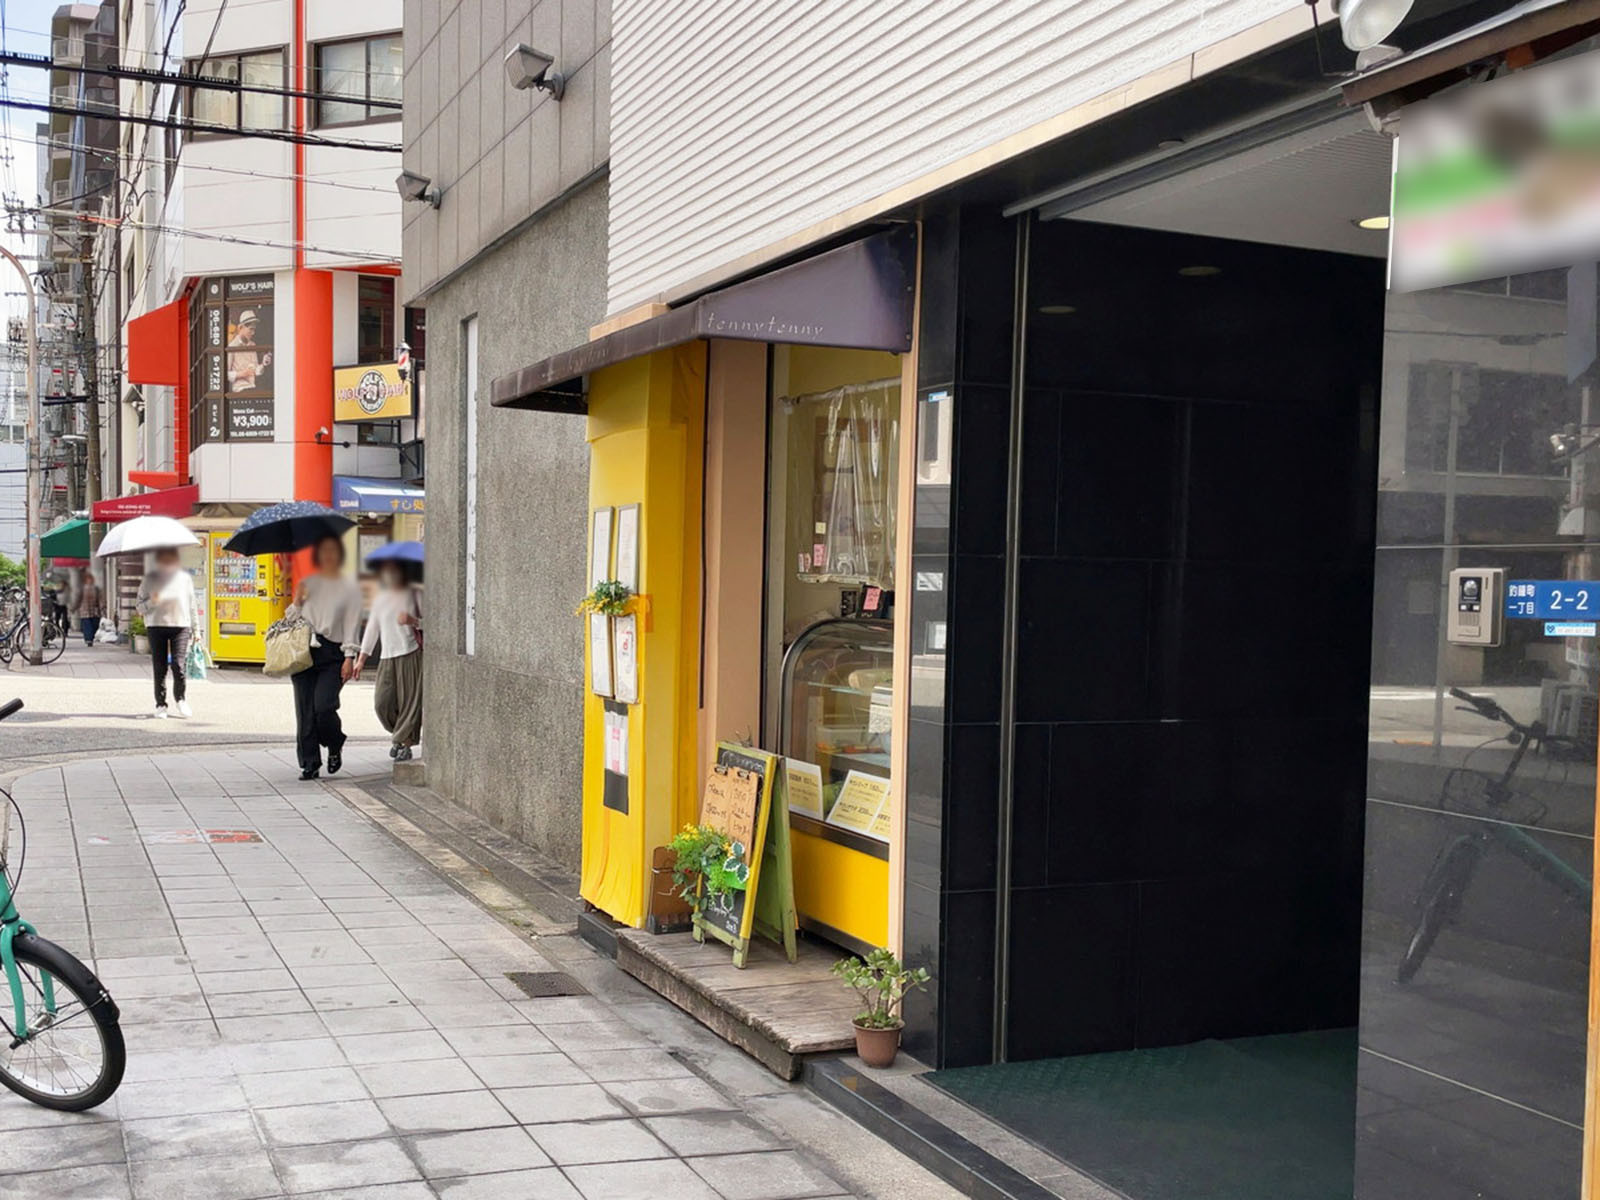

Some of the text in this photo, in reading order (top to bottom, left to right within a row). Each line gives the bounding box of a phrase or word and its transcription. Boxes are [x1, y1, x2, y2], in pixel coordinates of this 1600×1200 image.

[231, 282, 257, 291] WOLF'S
[257, 281, 274, 289] HAIR
[233, 415, 269, 428] ¥3,900
[1550, 590, 1589, 610] 2-2
[1508, 601, 1535, 615] 一丁目
